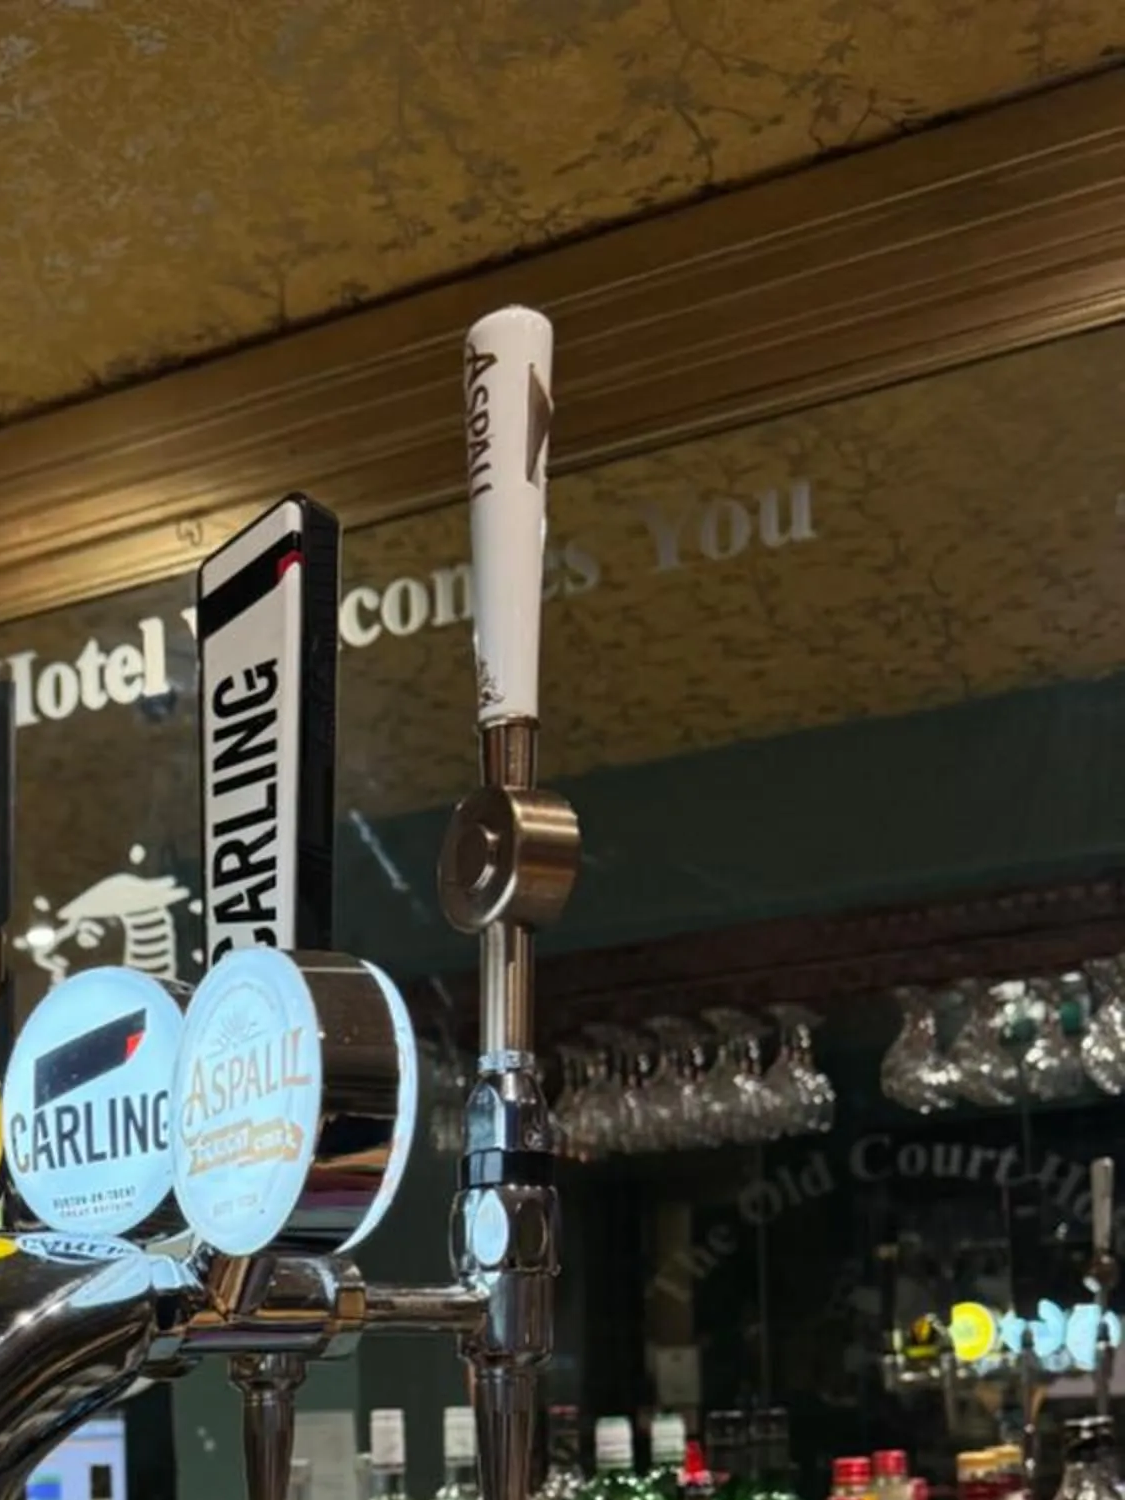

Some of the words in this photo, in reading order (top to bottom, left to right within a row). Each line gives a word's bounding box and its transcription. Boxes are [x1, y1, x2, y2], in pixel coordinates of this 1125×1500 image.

[637, 480, 819, 575] You
[182, 1027, 313, 1127] ASPALL
[738, 1151, 837, 1226] Old
[851, 1133, 1021, 1186] Court
